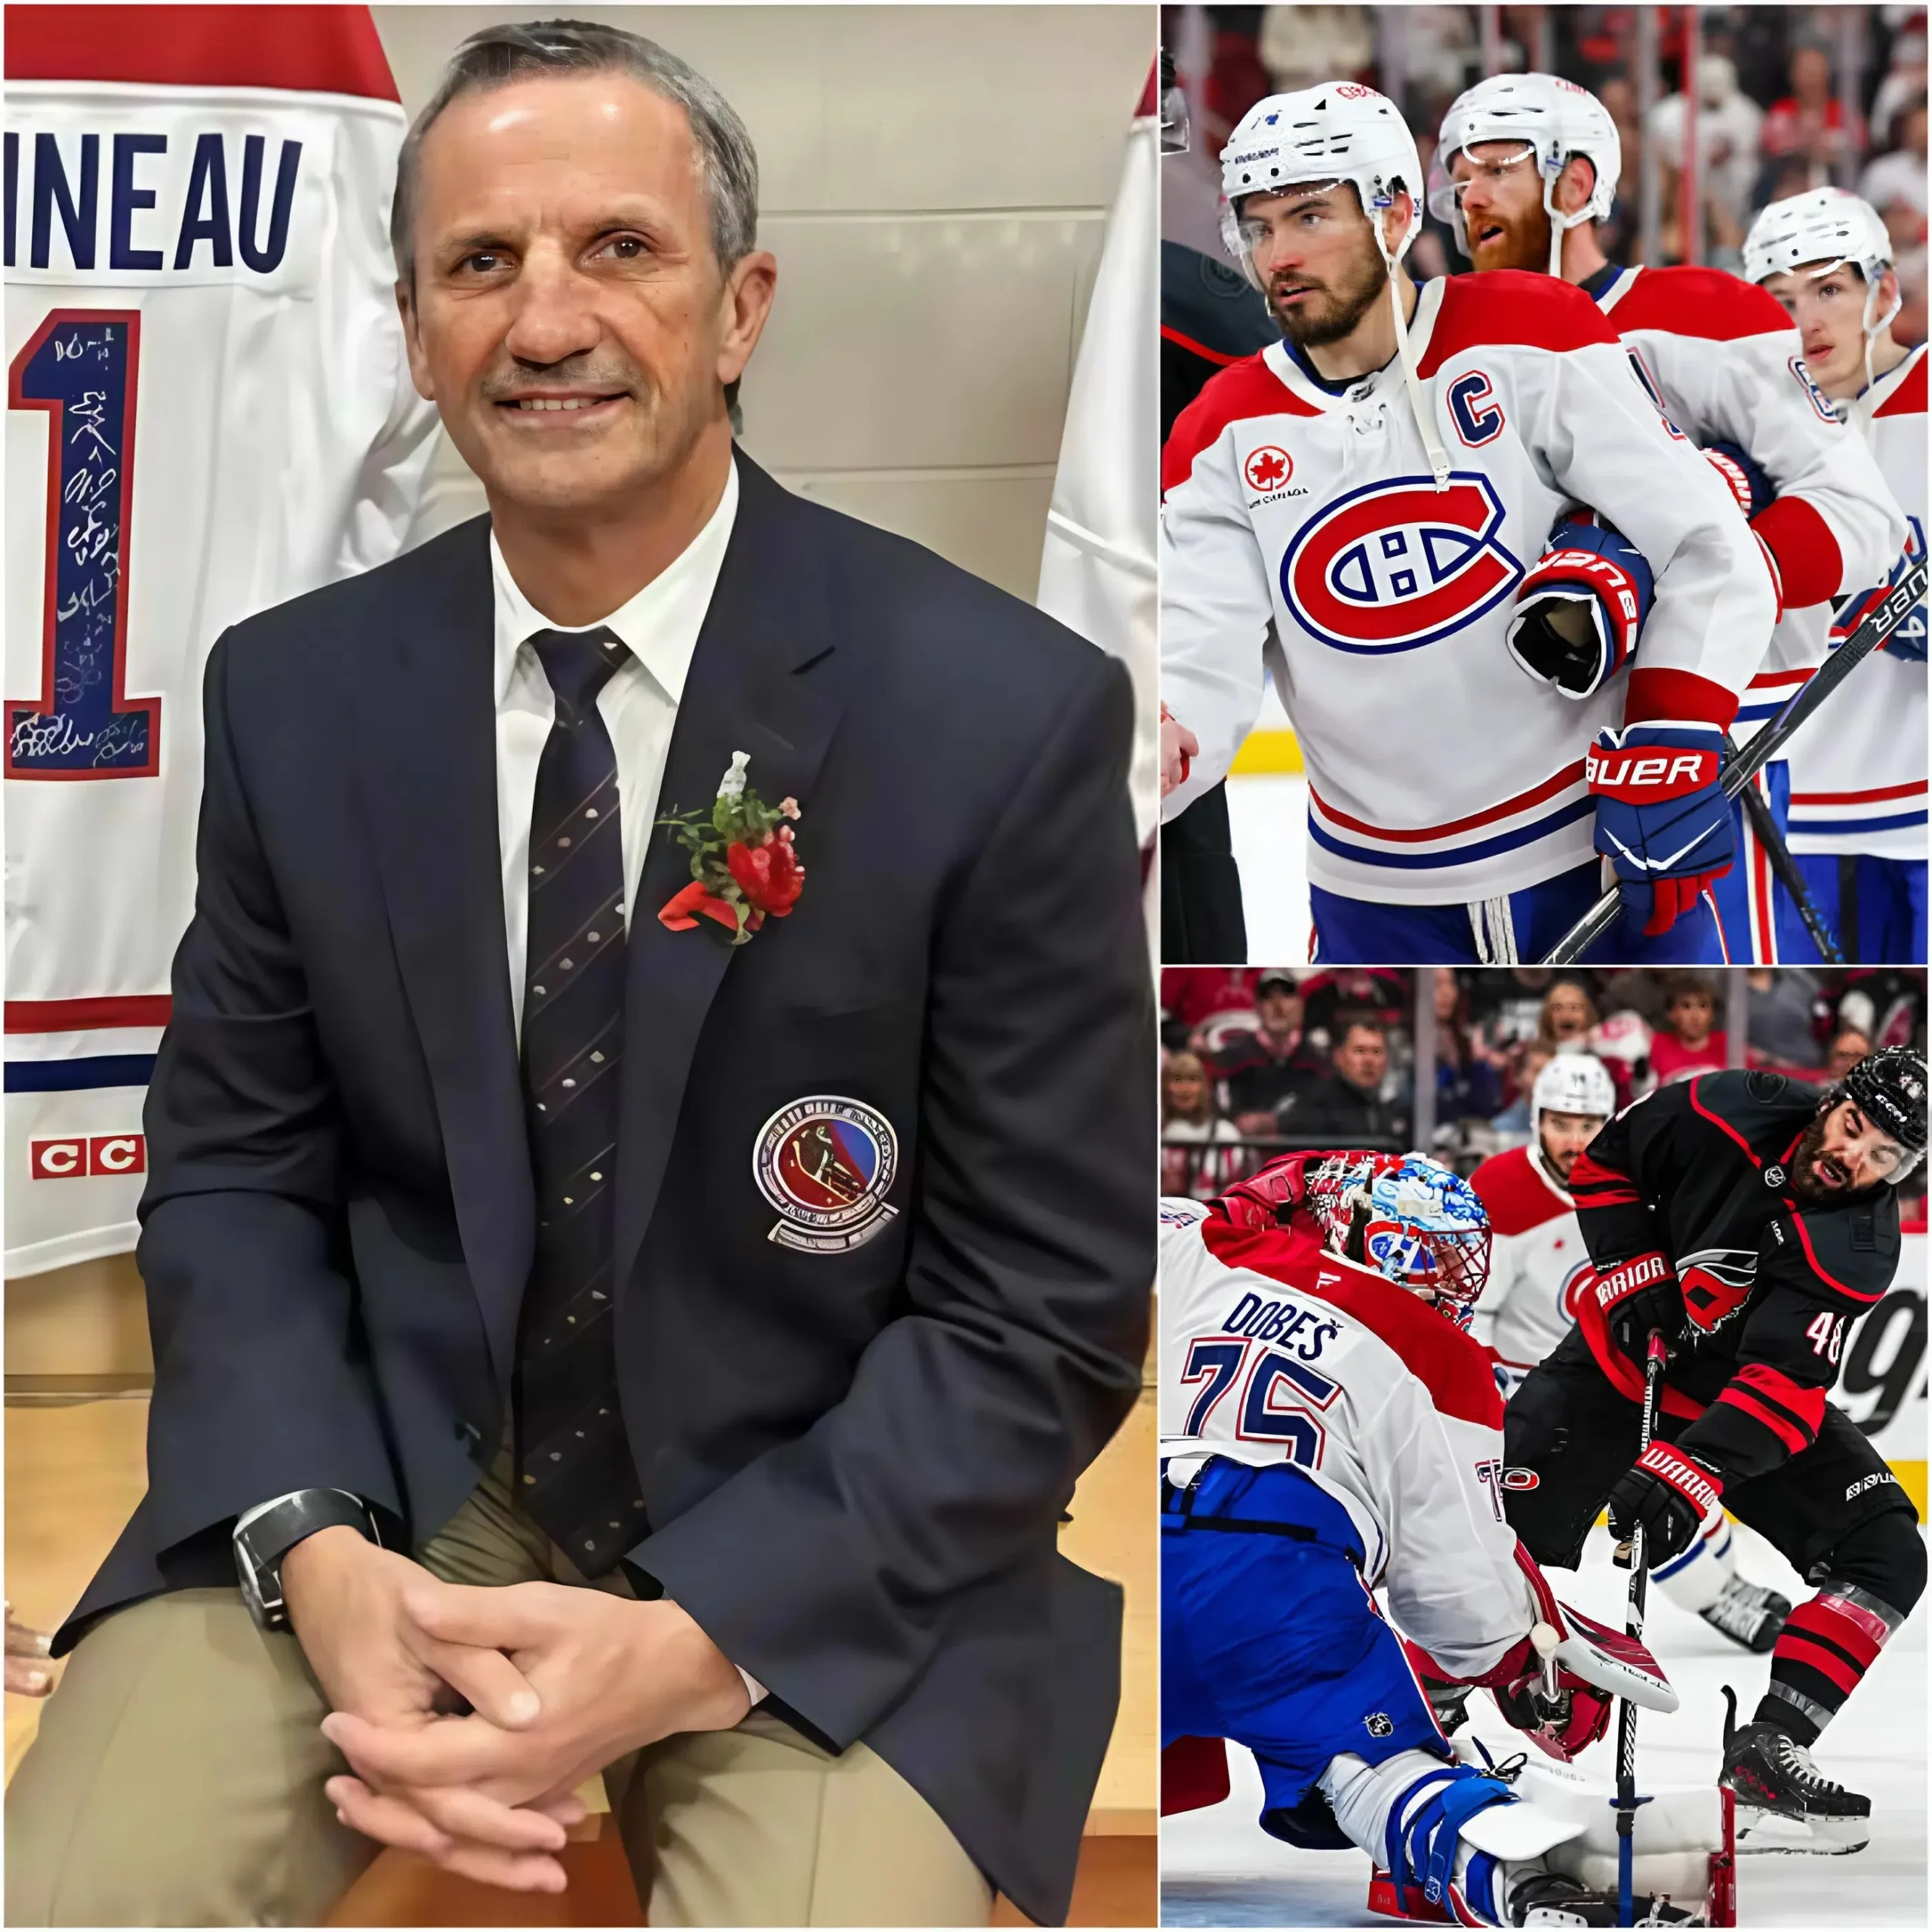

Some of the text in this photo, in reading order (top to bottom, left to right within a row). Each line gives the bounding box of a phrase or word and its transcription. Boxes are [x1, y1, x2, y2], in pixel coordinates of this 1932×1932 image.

[1447, 370, 1506, 448] C
[1222, 1291, 1344, 1361] DOBEŠ
[1805, 1312, 1847, 1367] 48
[1180, 1337, 1343, 1471] 75
[1641, 1447, 1715, 1511] WARRI
